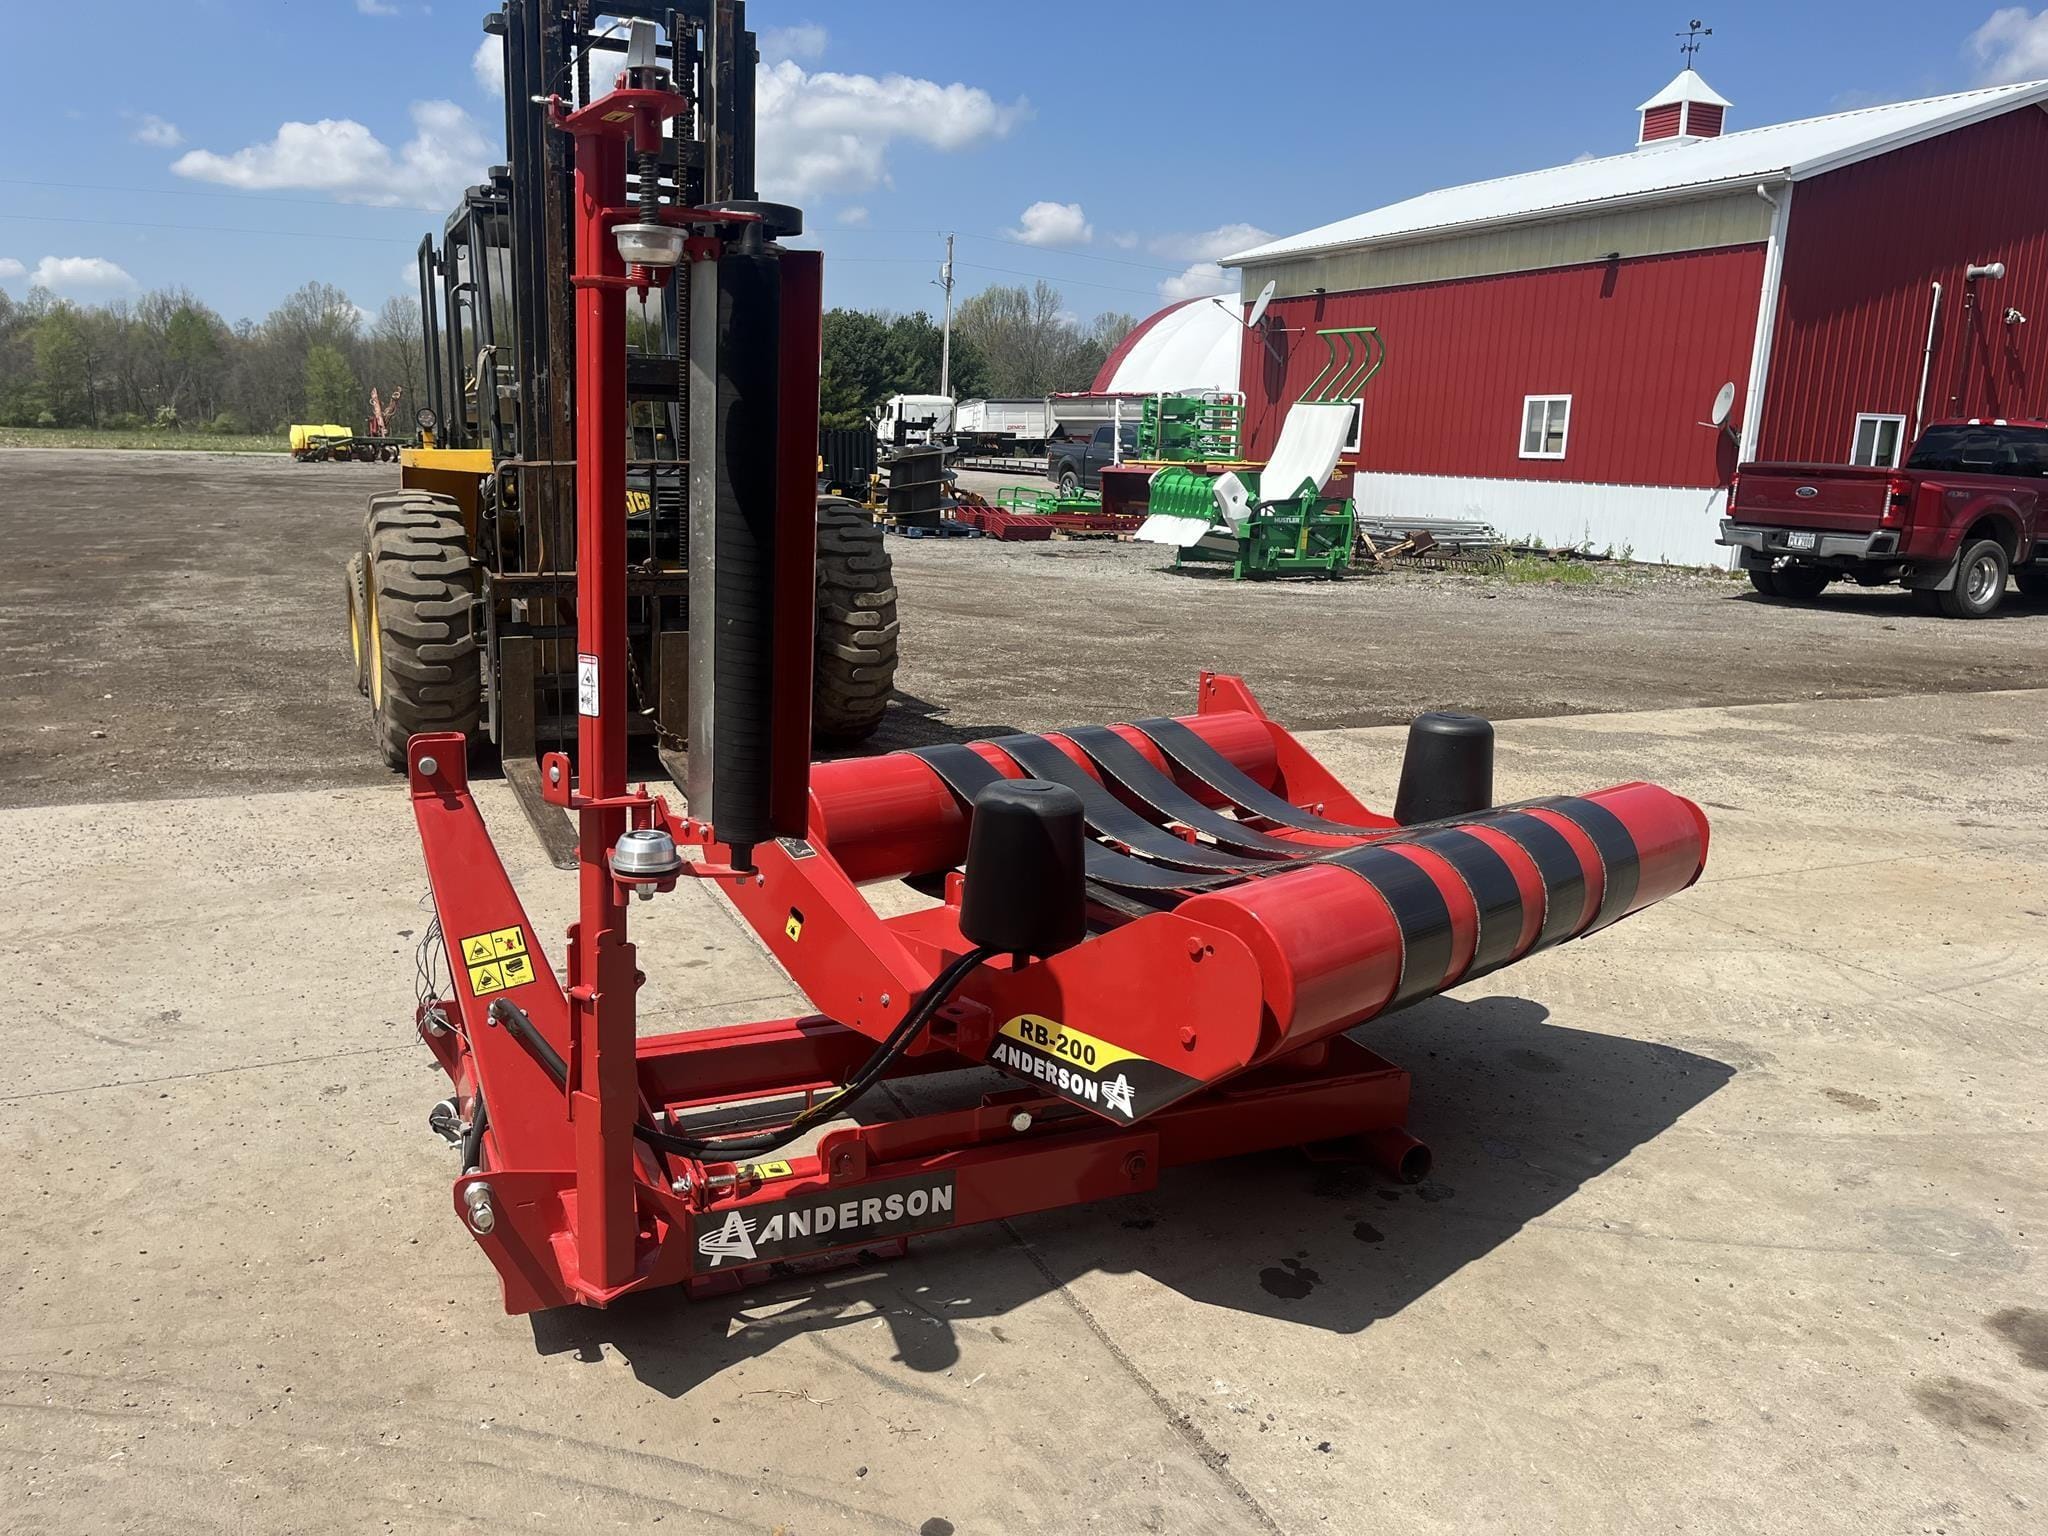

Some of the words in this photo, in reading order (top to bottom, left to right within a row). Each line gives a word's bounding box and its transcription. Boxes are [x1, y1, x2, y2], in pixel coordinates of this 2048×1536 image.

[1020, 1018, 1096, 1065] RB-200
[992, 1043, 1098, 1102] ANDERSON
[755, 1185, 953, 1245] ANDERSON
